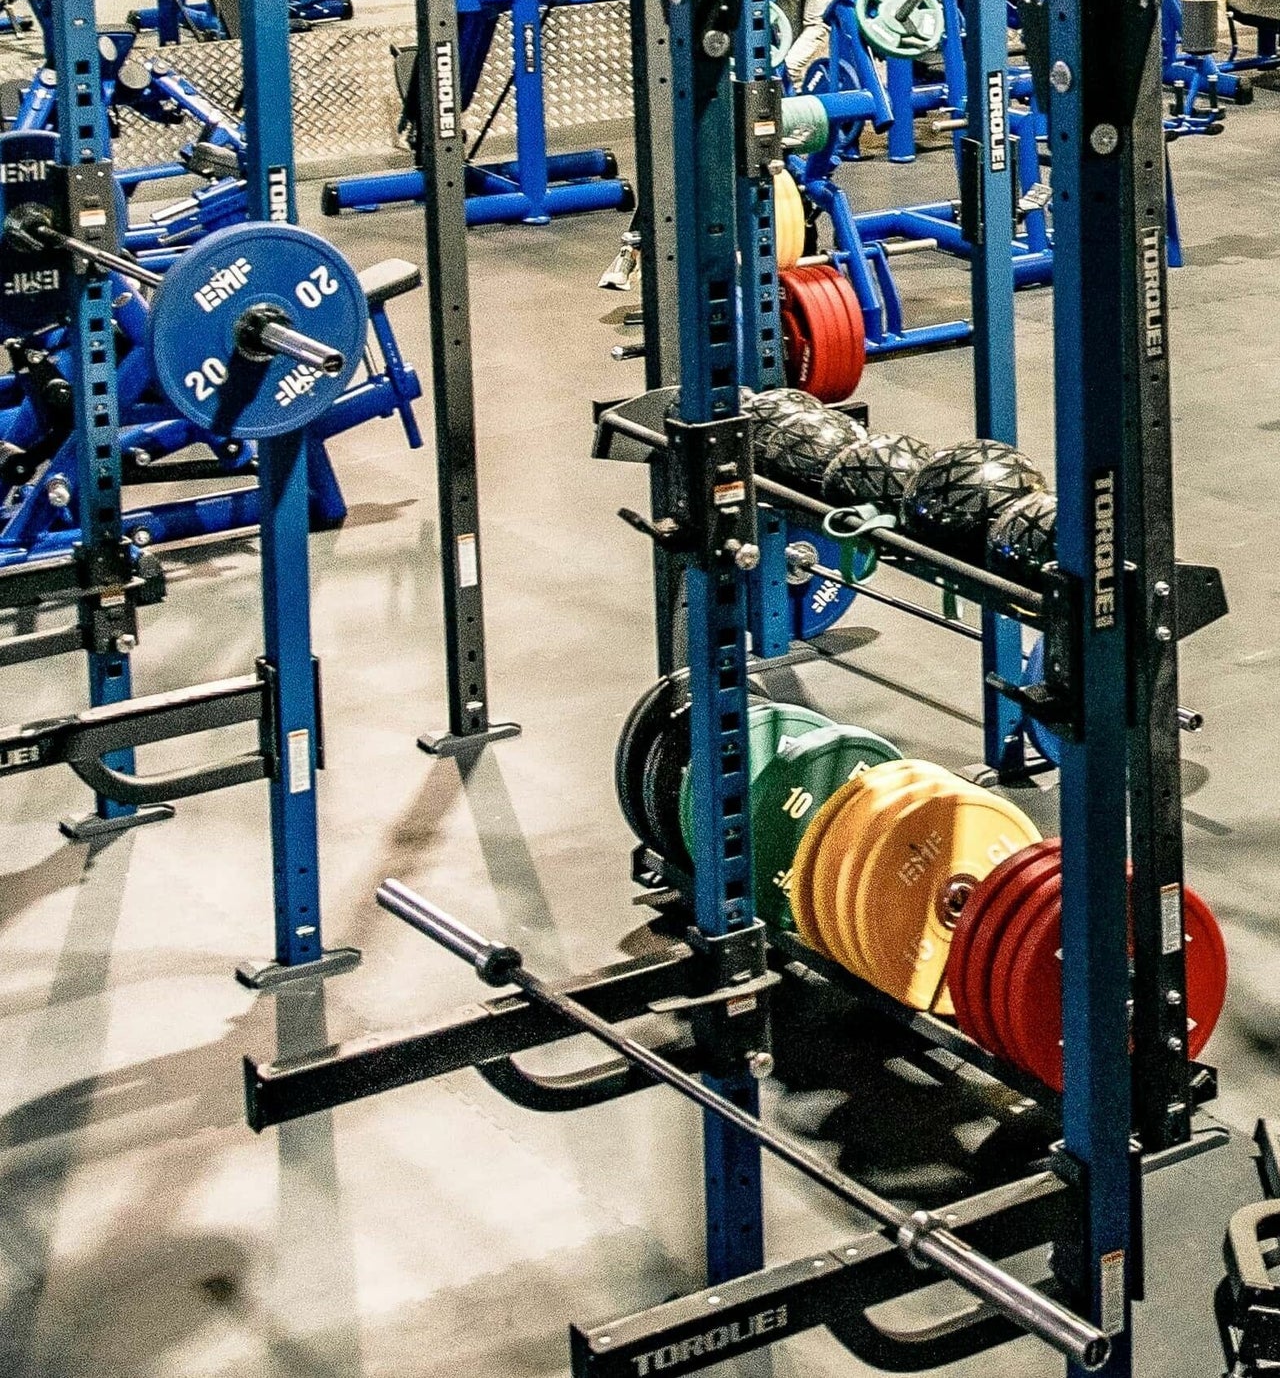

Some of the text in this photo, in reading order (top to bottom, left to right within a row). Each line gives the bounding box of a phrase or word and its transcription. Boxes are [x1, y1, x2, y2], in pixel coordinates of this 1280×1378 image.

[436, 42, 455, 131] TORQUE
[988, 72, 1006, 163] TORQUE
[268, 168, 288, 222] TOR
[193, 257, 252, 313] EMF
[295, 265, 339, 308] 20
[1141, 229, 1163, 348] TORQUE
[184, 357, 229, 402] 20
[1094, 471, 1114, 615] TORQUE
[781, 787, 814, 819] 10
[630, 1307, 778, 1377] TORQUE
